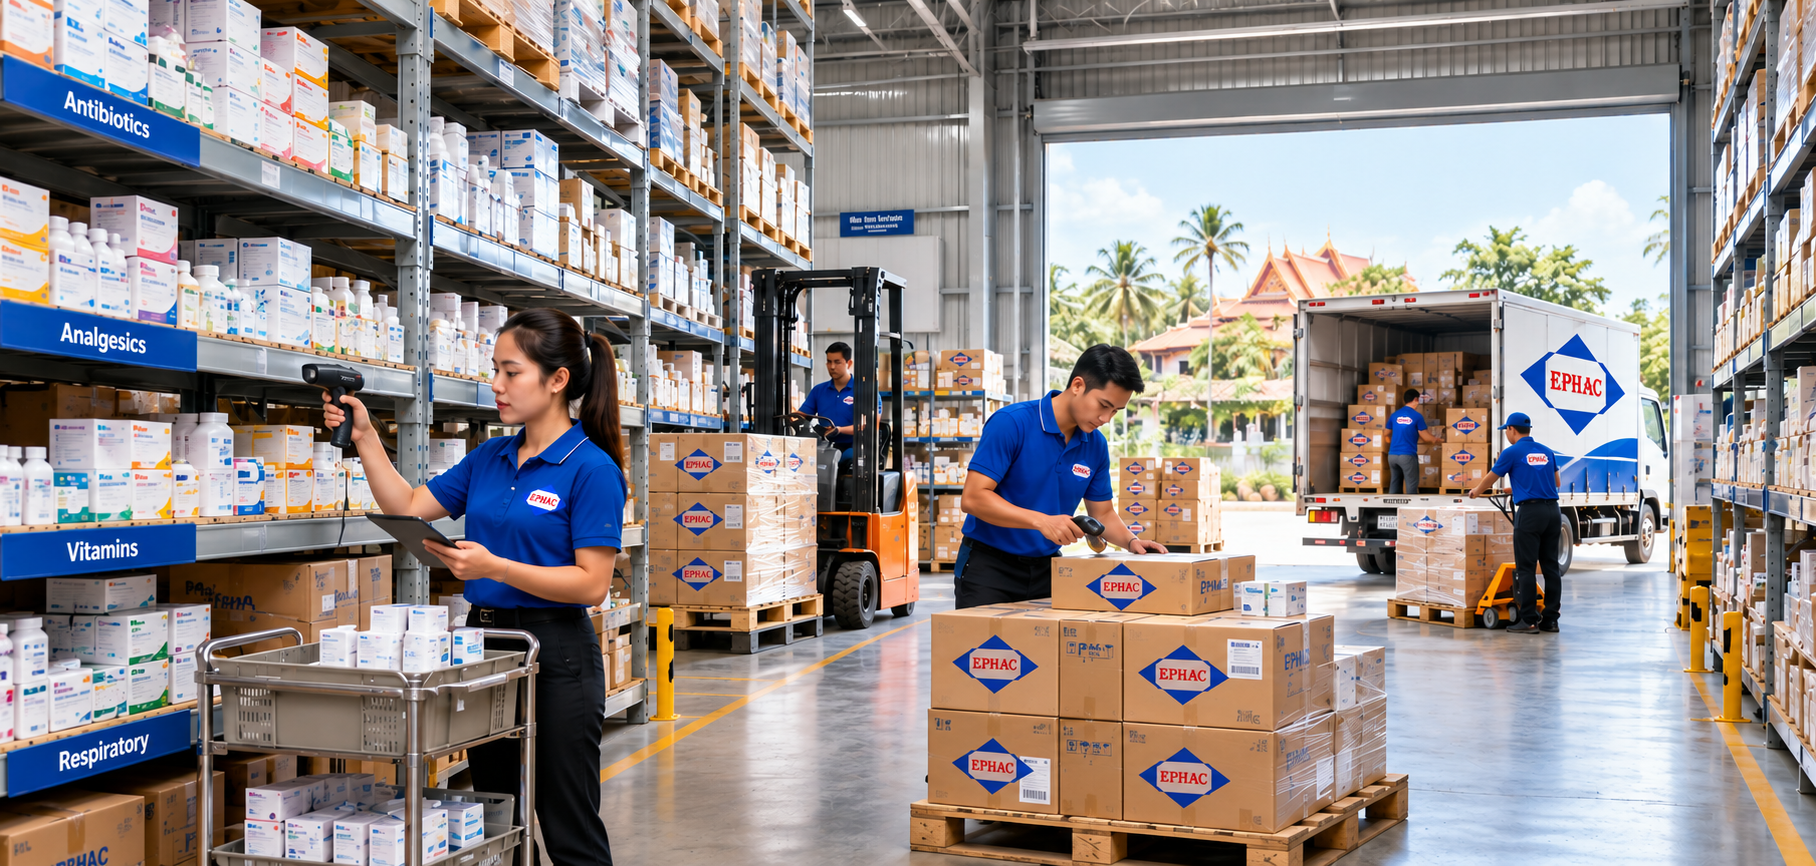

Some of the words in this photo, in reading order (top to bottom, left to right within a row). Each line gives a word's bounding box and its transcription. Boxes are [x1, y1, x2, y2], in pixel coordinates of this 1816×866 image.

[64, 91, 150, 138] Antibiotics
[60, 322, 146, 353] Analgesics
[1550, 370, 1603, 397] EPHAC
[529, 493, 558, 507] EPHAC
[67, 538, 138, 562] Vitamins
[1103, 581, 1140, 592] EPHAC
[972, 657, 1017, 671] EPHAC
[1158, 667, 1207, 683] EPHAC
[59, 734, 149, 772] Respiratory
[971, 759, 1014, 774] EPHAC
[1160, 770, 1208, 785] EPHAC
